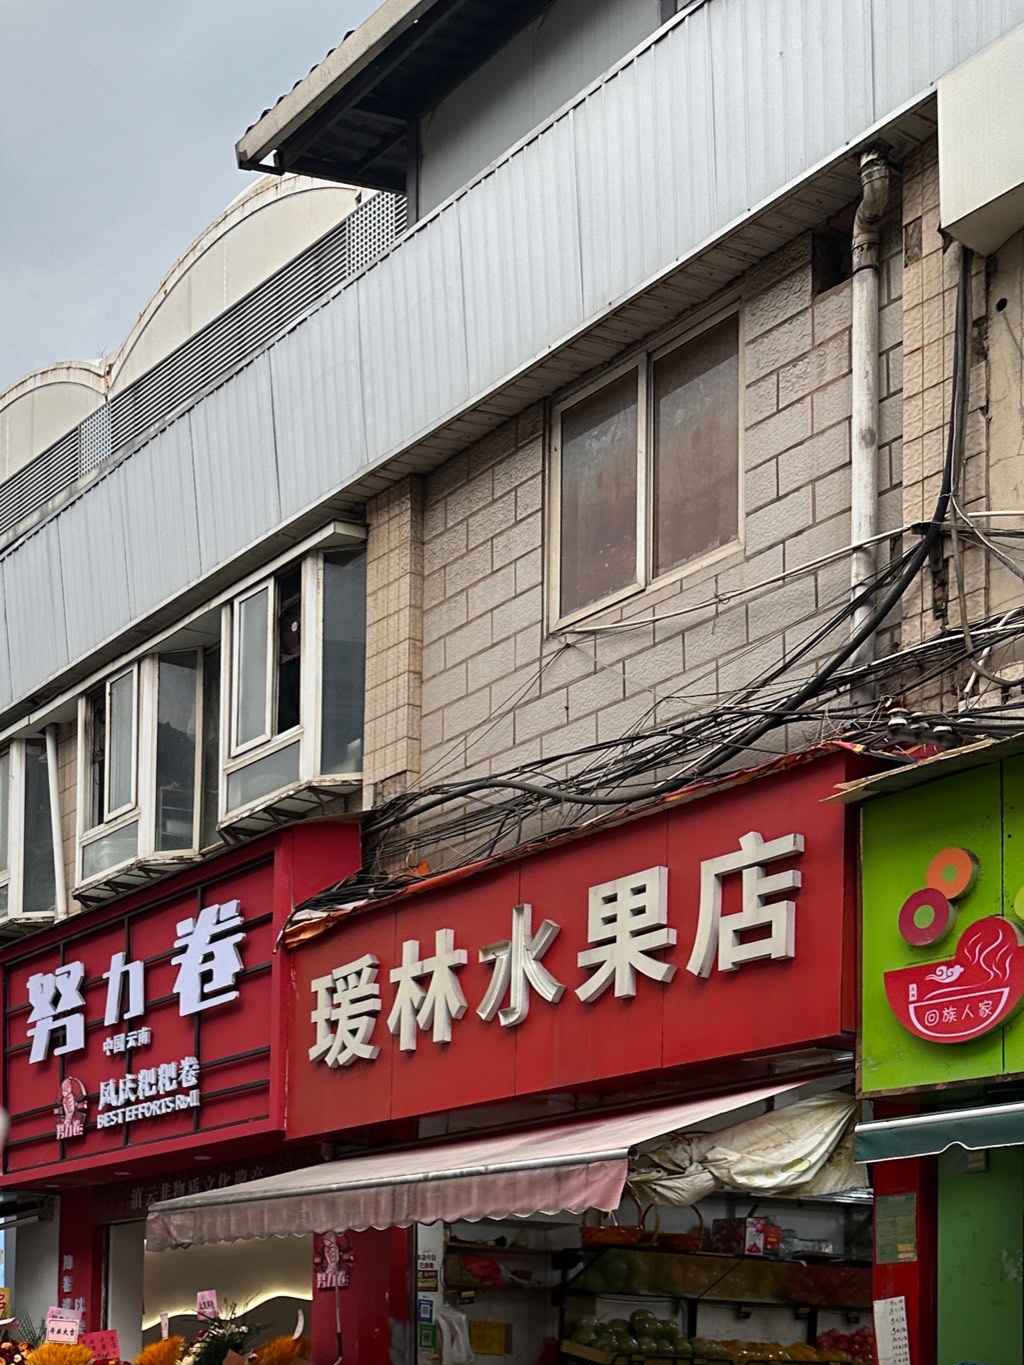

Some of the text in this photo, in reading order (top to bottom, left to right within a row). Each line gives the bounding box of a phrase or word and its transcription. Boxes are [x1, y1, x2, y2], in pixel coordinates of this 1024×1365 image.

[27, 900, 246, 1064] 努力卷
[925, 1000, 993, 1026] 回族人家
[102, 1027, 152, 1055] 中国云南
[97, 1108, 126, 1129] BEST
[125, 1097, 176, 1122] EFFORTS
[56, 1120, 84, 1139] 努力卷
